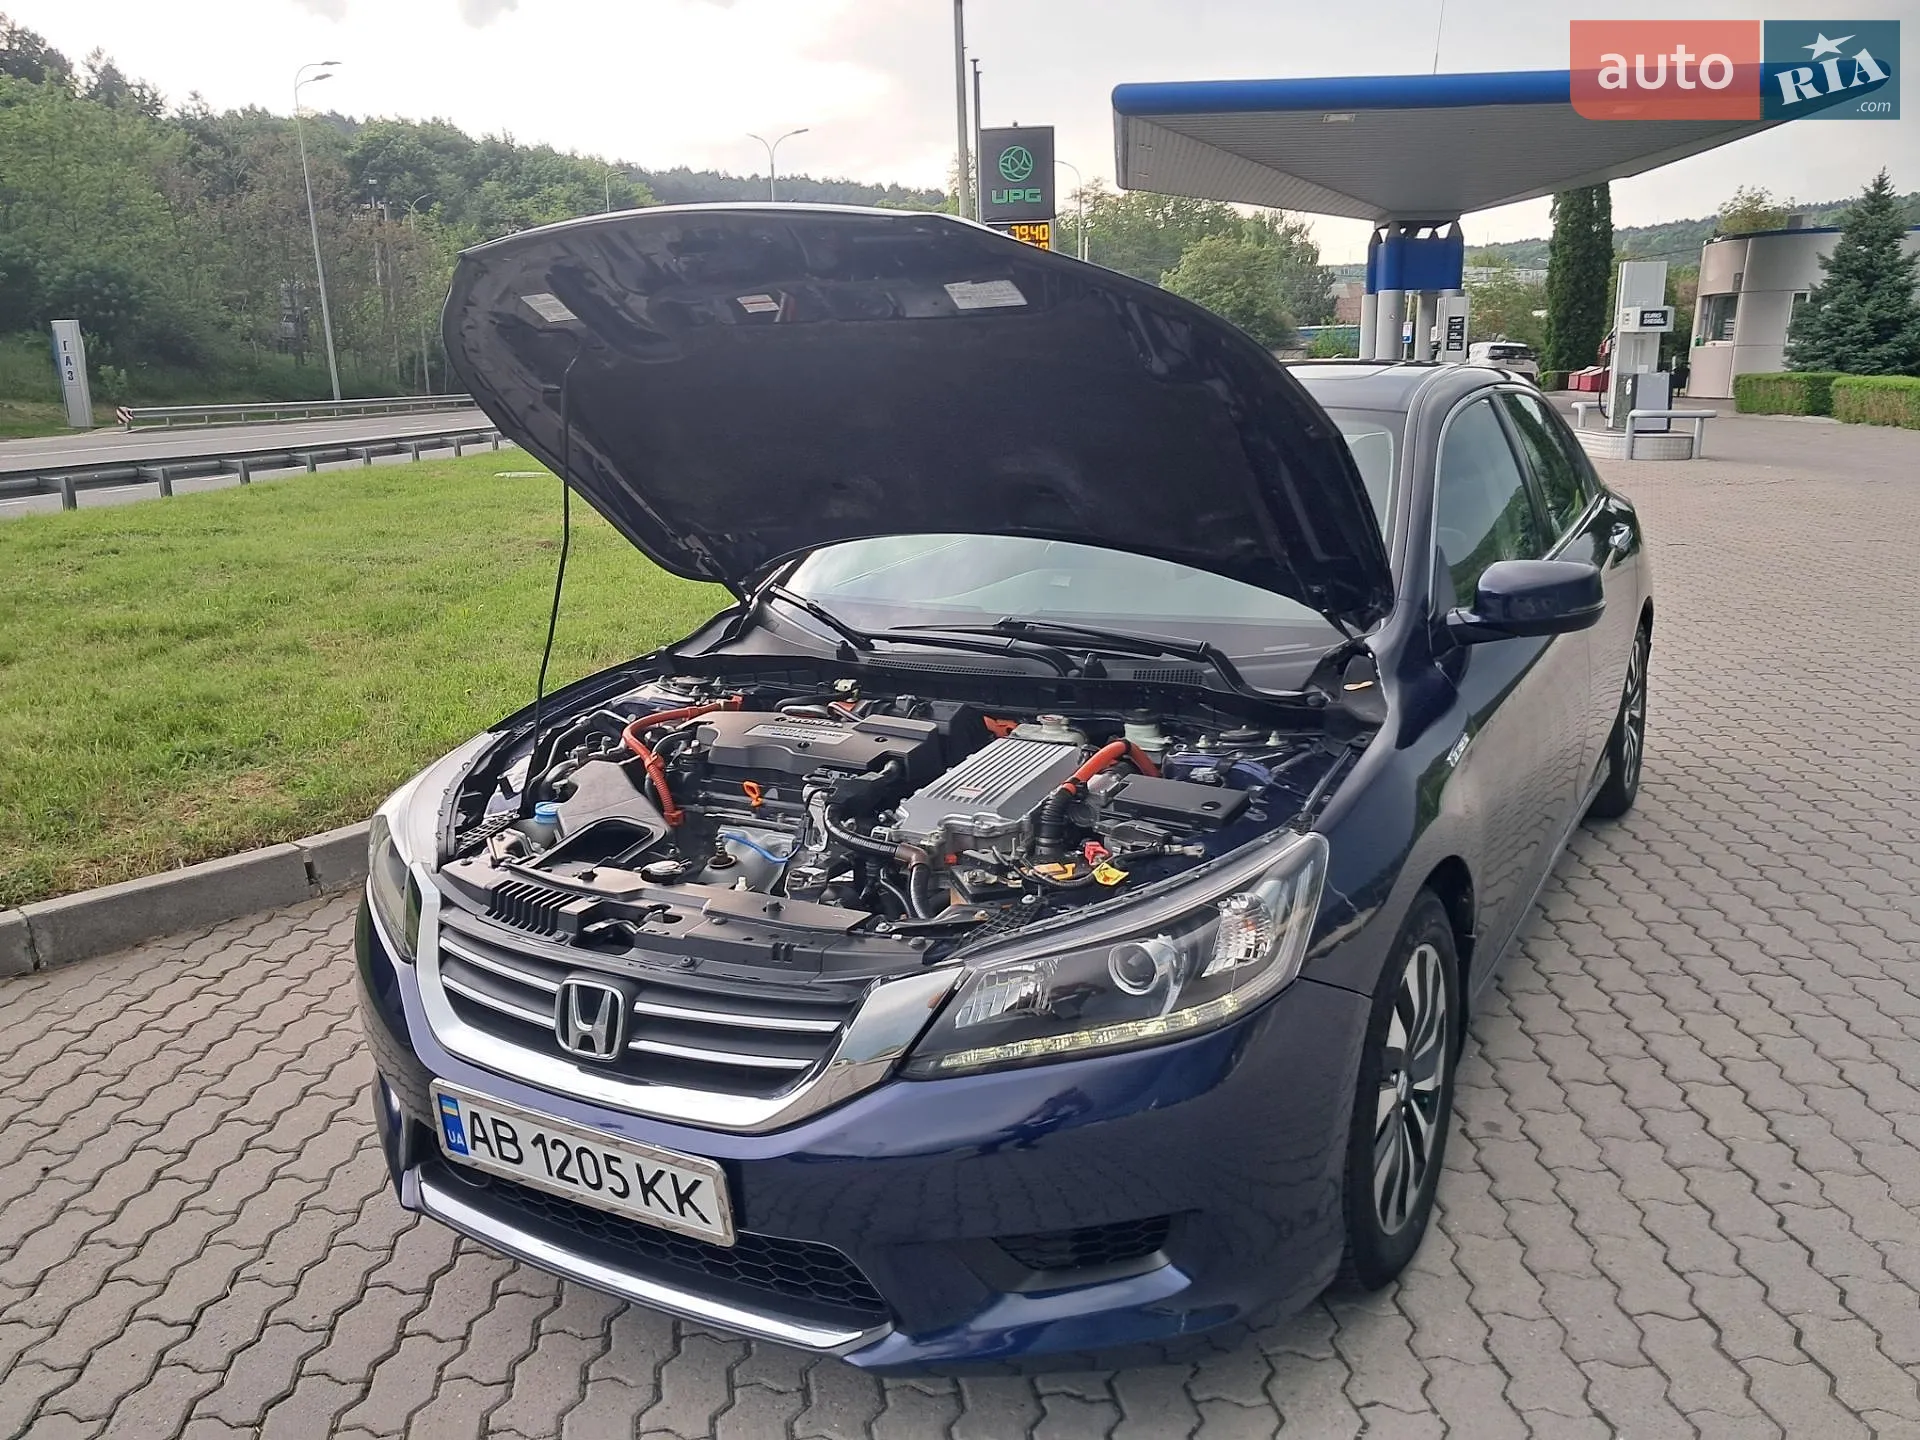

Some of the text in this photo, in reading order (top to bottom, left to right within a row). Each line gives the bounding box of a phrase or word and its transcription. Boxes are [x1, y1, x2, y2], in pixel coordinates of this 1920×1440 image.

[991, 188, 1042, 204] UPG
[447, 1128, 466, 1147] UA
[470, 1111, 712, 1225] AB 1205 KK
